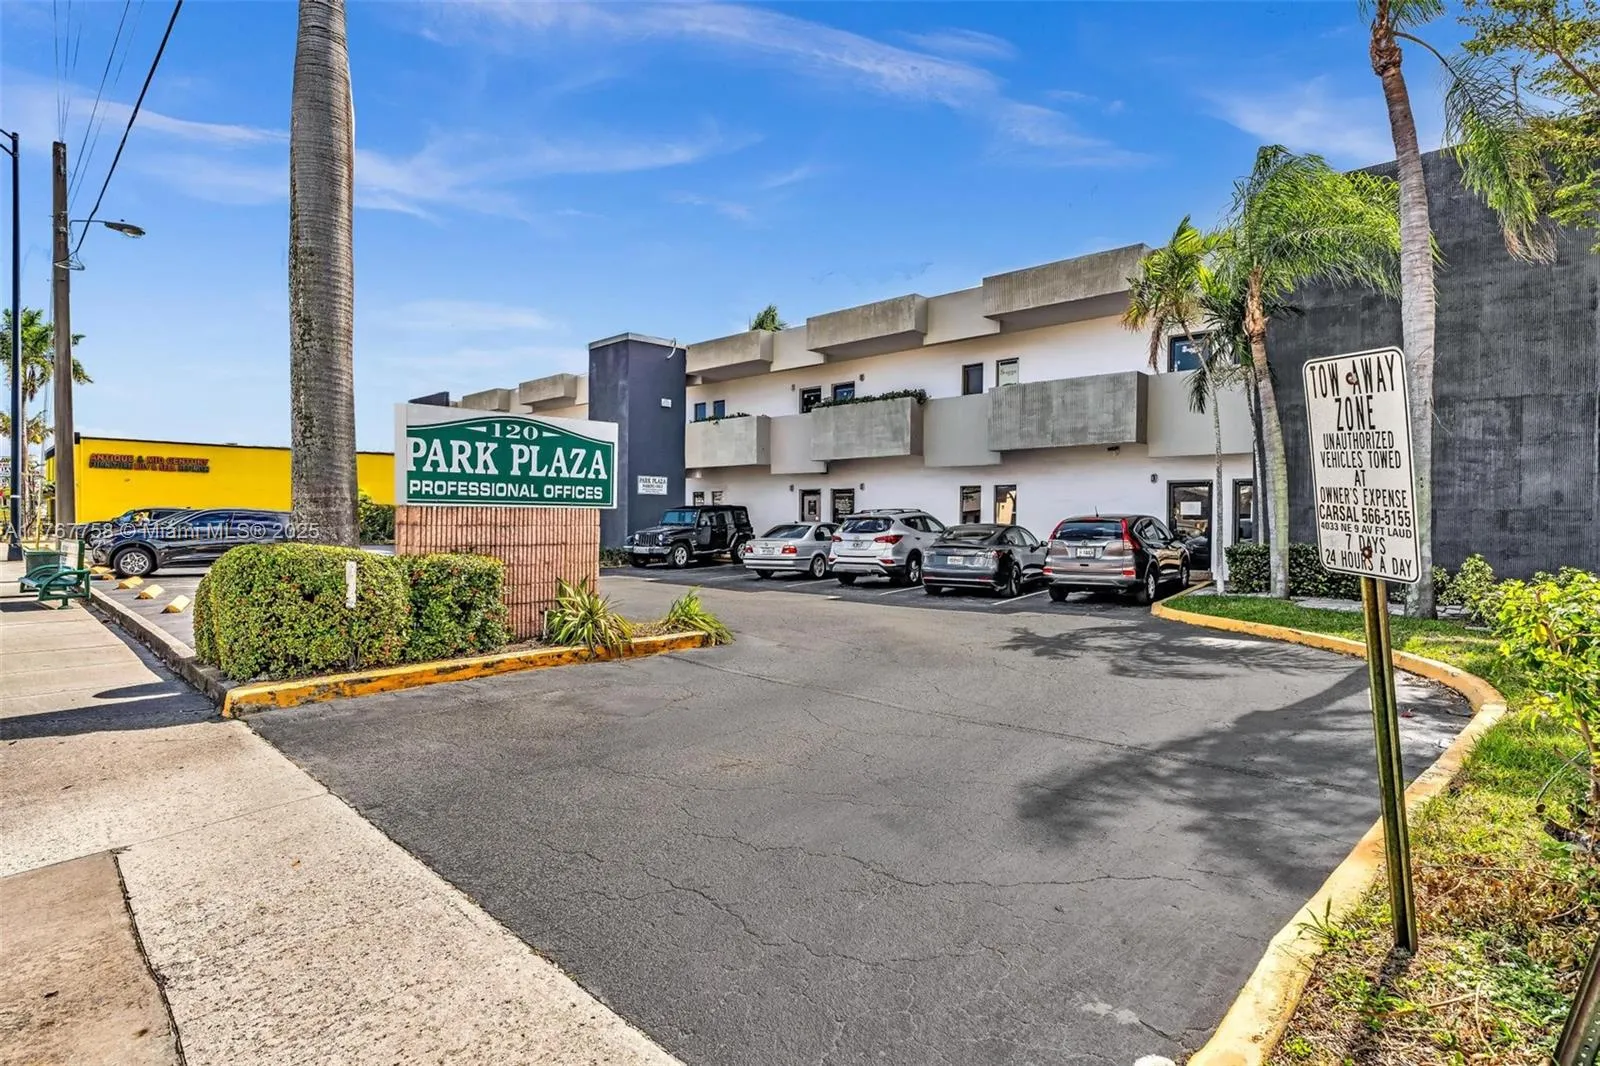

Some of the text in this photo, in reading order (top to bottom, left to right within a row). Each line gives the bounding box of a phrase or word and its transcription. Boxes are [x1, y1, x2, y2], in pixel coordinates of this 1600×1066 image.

[1310, 354, 1394, 398] TOW AWAY
[1335, 395, 1376, 431] ZONE
[490, 423, 539, 440] 120
[1323, 431, 1394, 450] UNAUTHORIZED
[89, 453, 134, 463] ANTIQUE
[146, 456, 164, 465] MID
[406, 436, 608, 480] PARK PLAZA
[1320, 450, 1401, 468] VEHICLES TOWED
[1354, 470, 1366, 487] AT
[409, 479, 603, 499] PROFESSIONAL OFFICES
[1320, 486, 1408, 508] OWNER'S EXPENSE
[1319, 504, 1411, 527] CARSAL 566-5155
[1321, 521, 1412, 539] 4033 NE 9 AV FT LAUD
[1345, 534, 1386, 555] 7 DAYS
[1325, 548, 1412, 577] 24 HOURS A DAY
